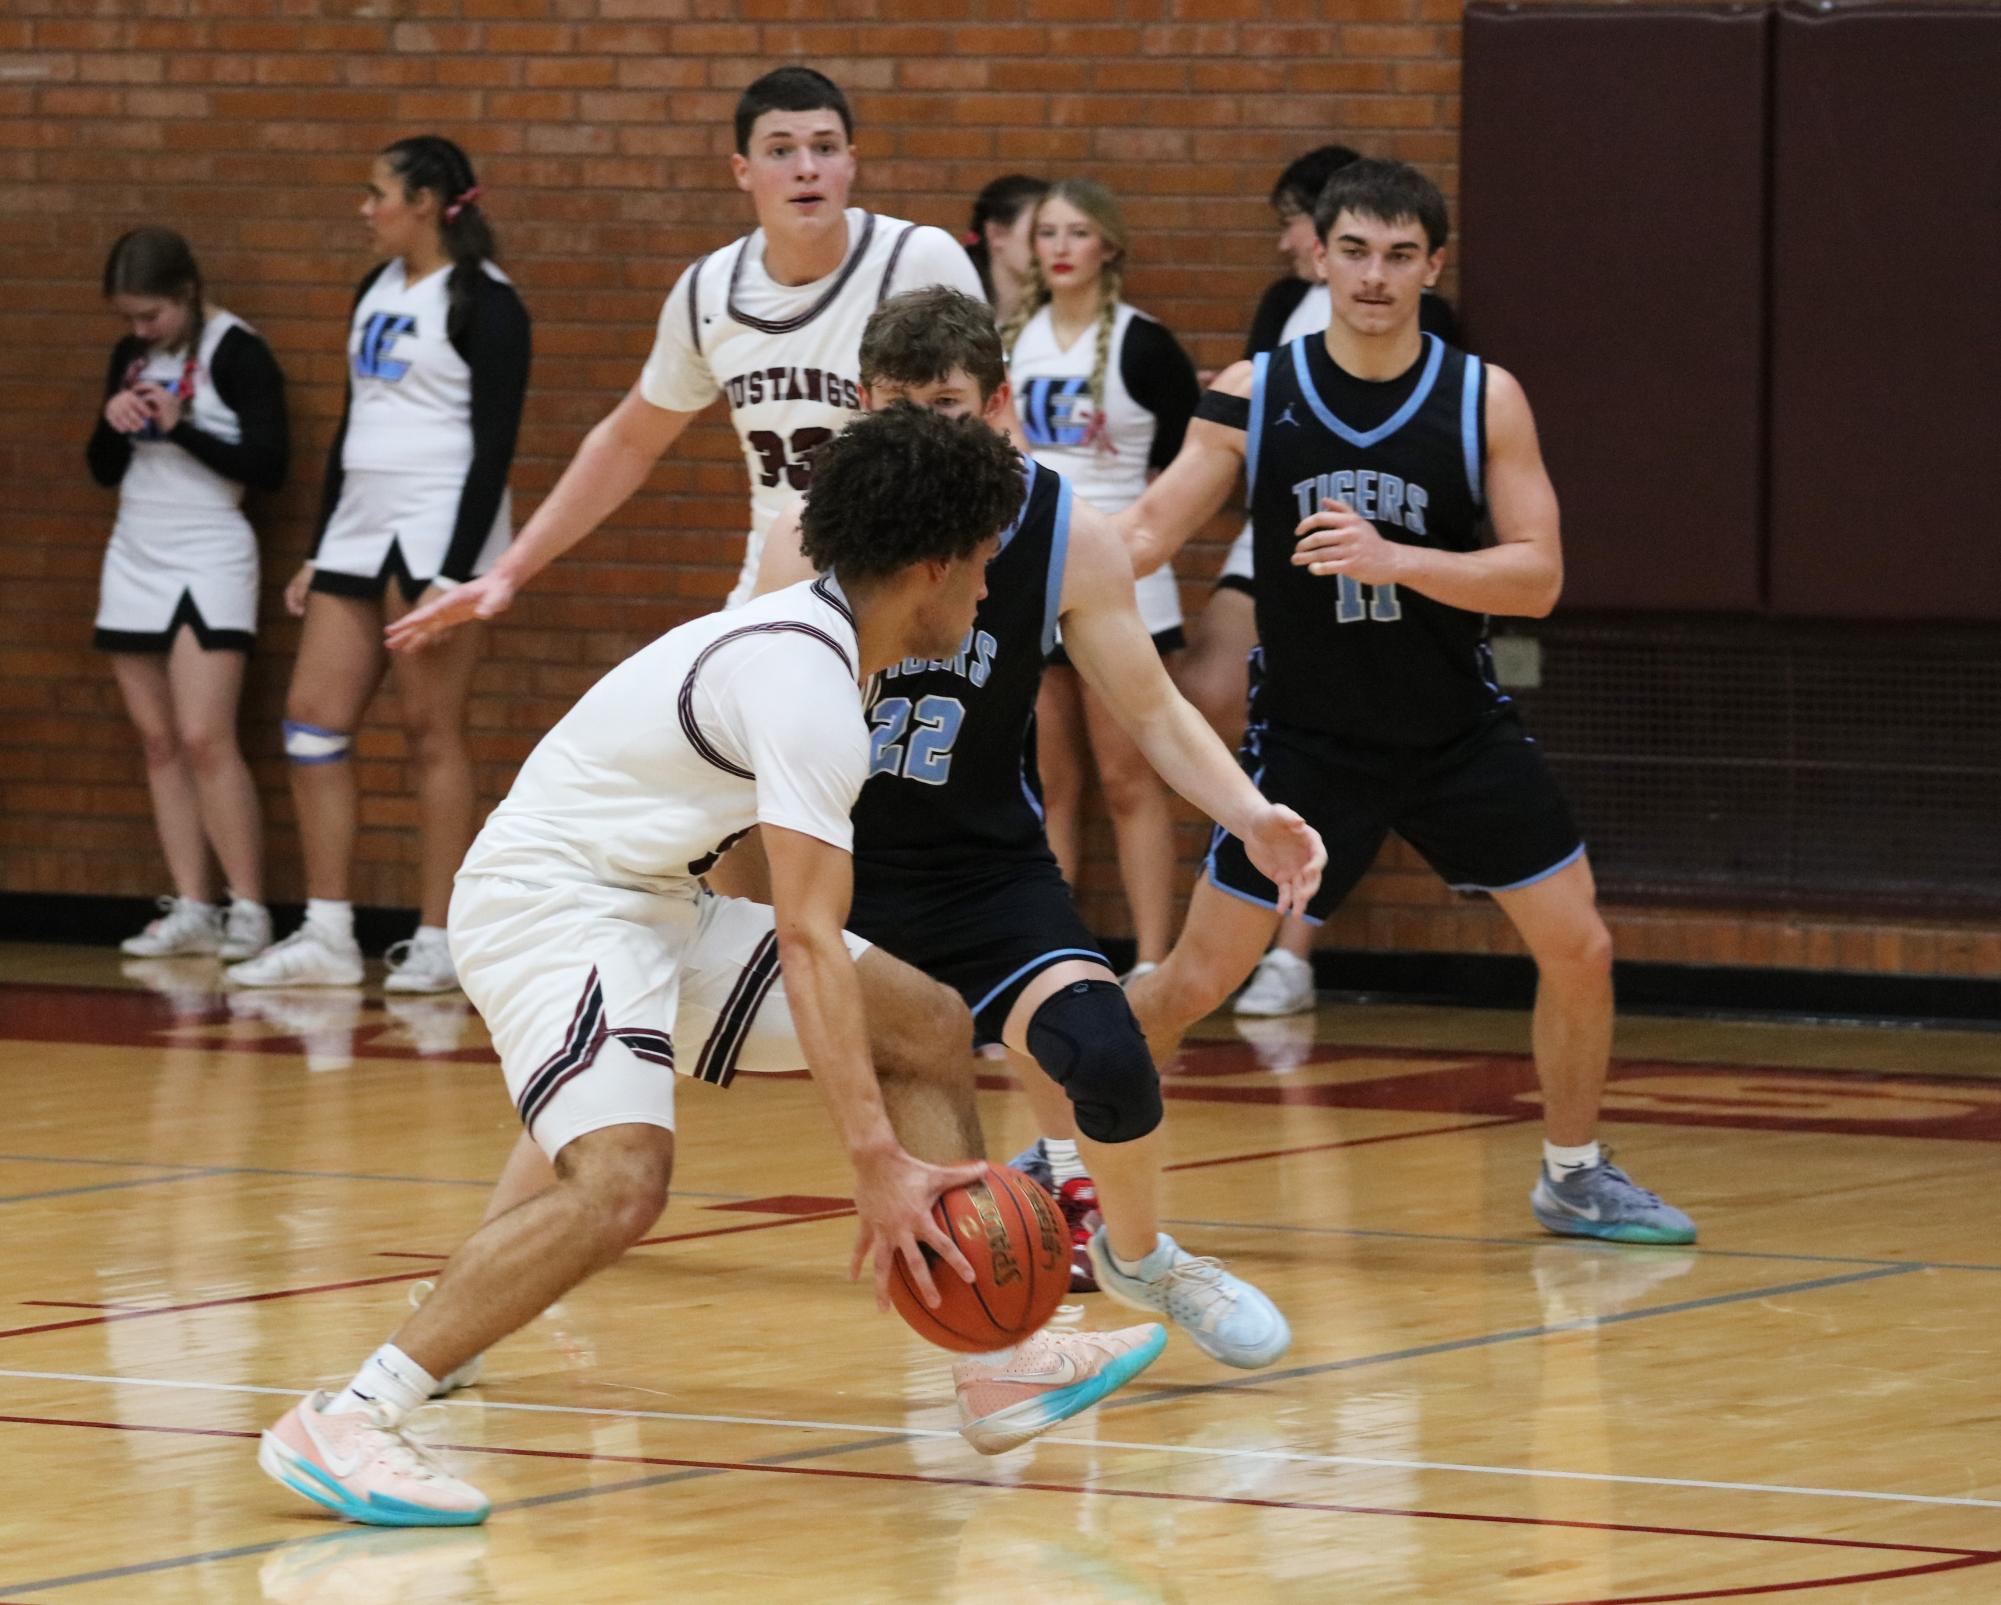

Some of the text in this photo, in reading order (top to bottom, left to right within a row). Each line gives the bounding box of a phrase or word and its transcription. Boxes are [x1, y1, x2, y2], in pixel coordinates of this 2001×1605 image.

[726, 366, 859, 409] USTANGS
[1291, 469, 1429, 536] TIGERS
[869, 694, 966, 786] 22
